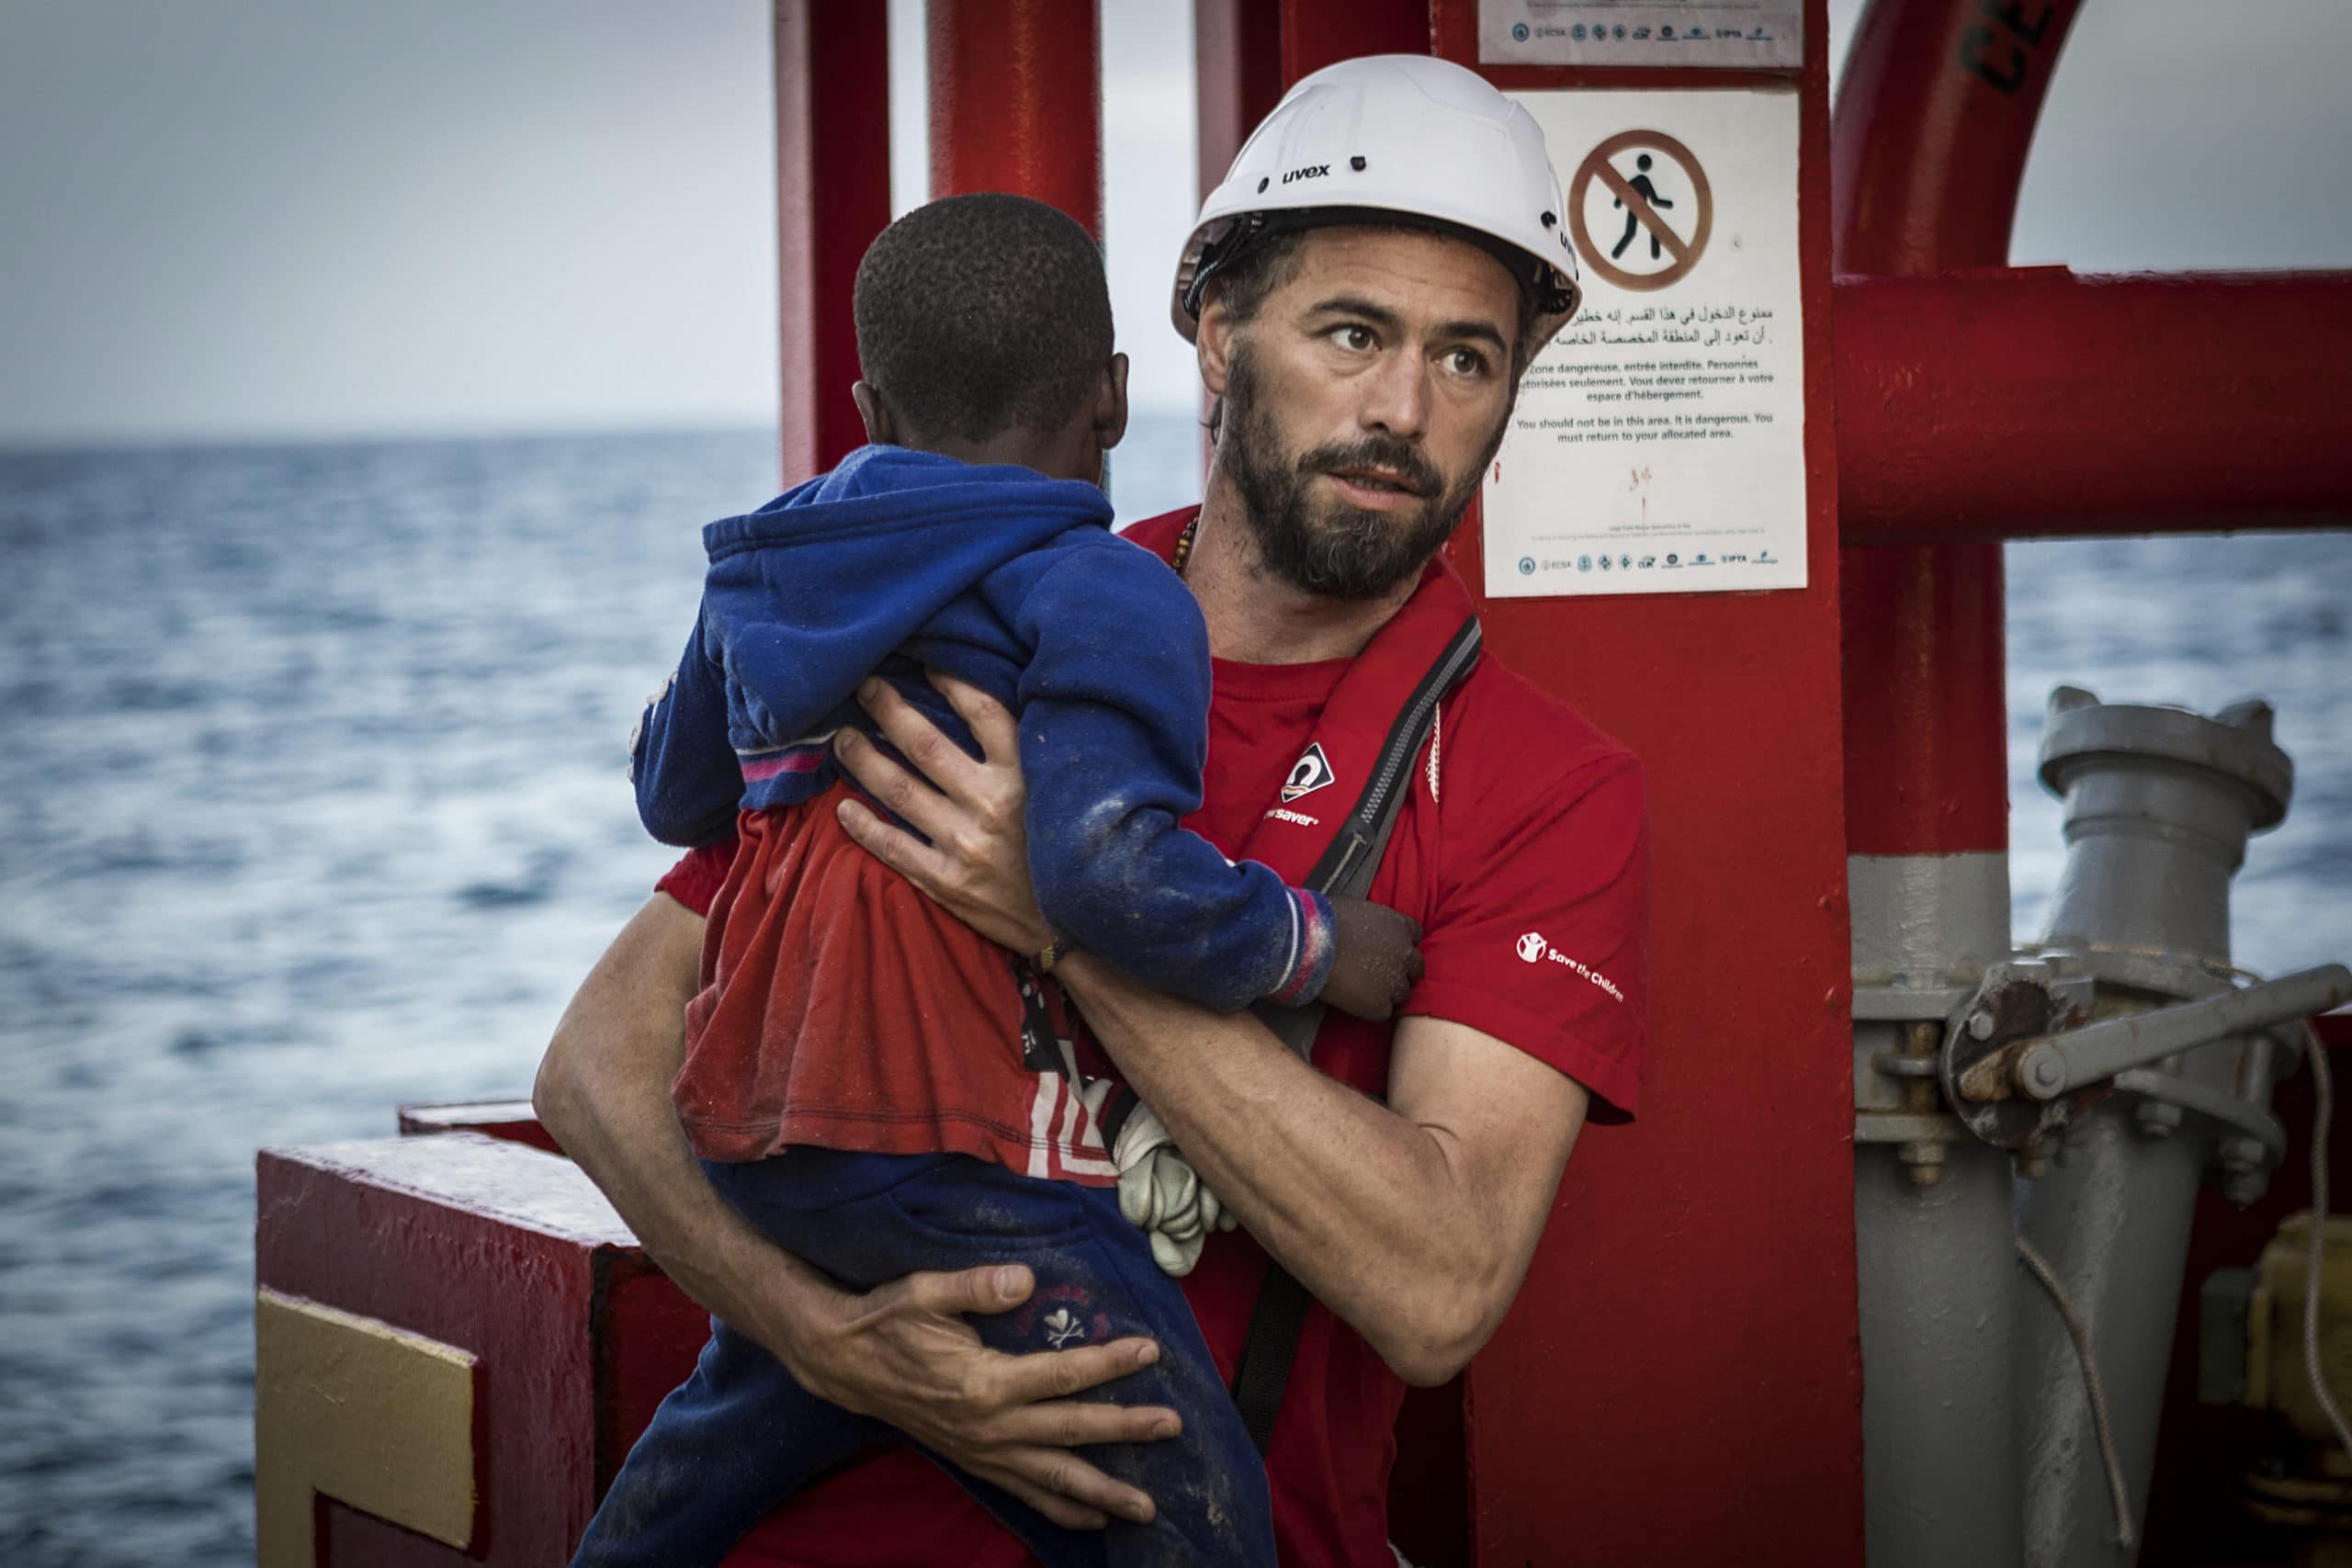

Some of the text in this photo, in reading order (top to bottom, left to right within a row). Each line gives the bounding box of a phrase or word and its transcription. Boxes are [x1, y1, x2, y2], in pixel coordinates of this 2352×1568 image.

[1283, 164, 1330, 185] uvex
[1660, 309, 1675, 321] هذا
[1681, 309, 1695, 325] في
[1699, 306, 1735, 323] الدخول
[1739, 309, 1773, 325] ممنوع
[1601, 331, 1658, 344] المخصصة
[1663, 330, 1700, 343] المنطقة
[1725, 331, 1749, 345] تعود
[1556, 363, 1622, 377] dangereuse,
[1623, 360, 1657, 372] entrée
[1658, 359, 1704, 371] interdite.
[1706, 359, 1758, 370] Personnes
[1519, 373, 1774, 389] utorisées seulement. Vous devez retourner à votre
[1586, 389, 1704, 404] espace d'hébergement.
[1516, 412, 1773, 430] You should not be in this area. It is dangerous. You
[1557, 428, 1734, 443] must return to your allocated area.
[1547, 948, 1577, 969] Save
[1577, 964, 1590, 979] the
